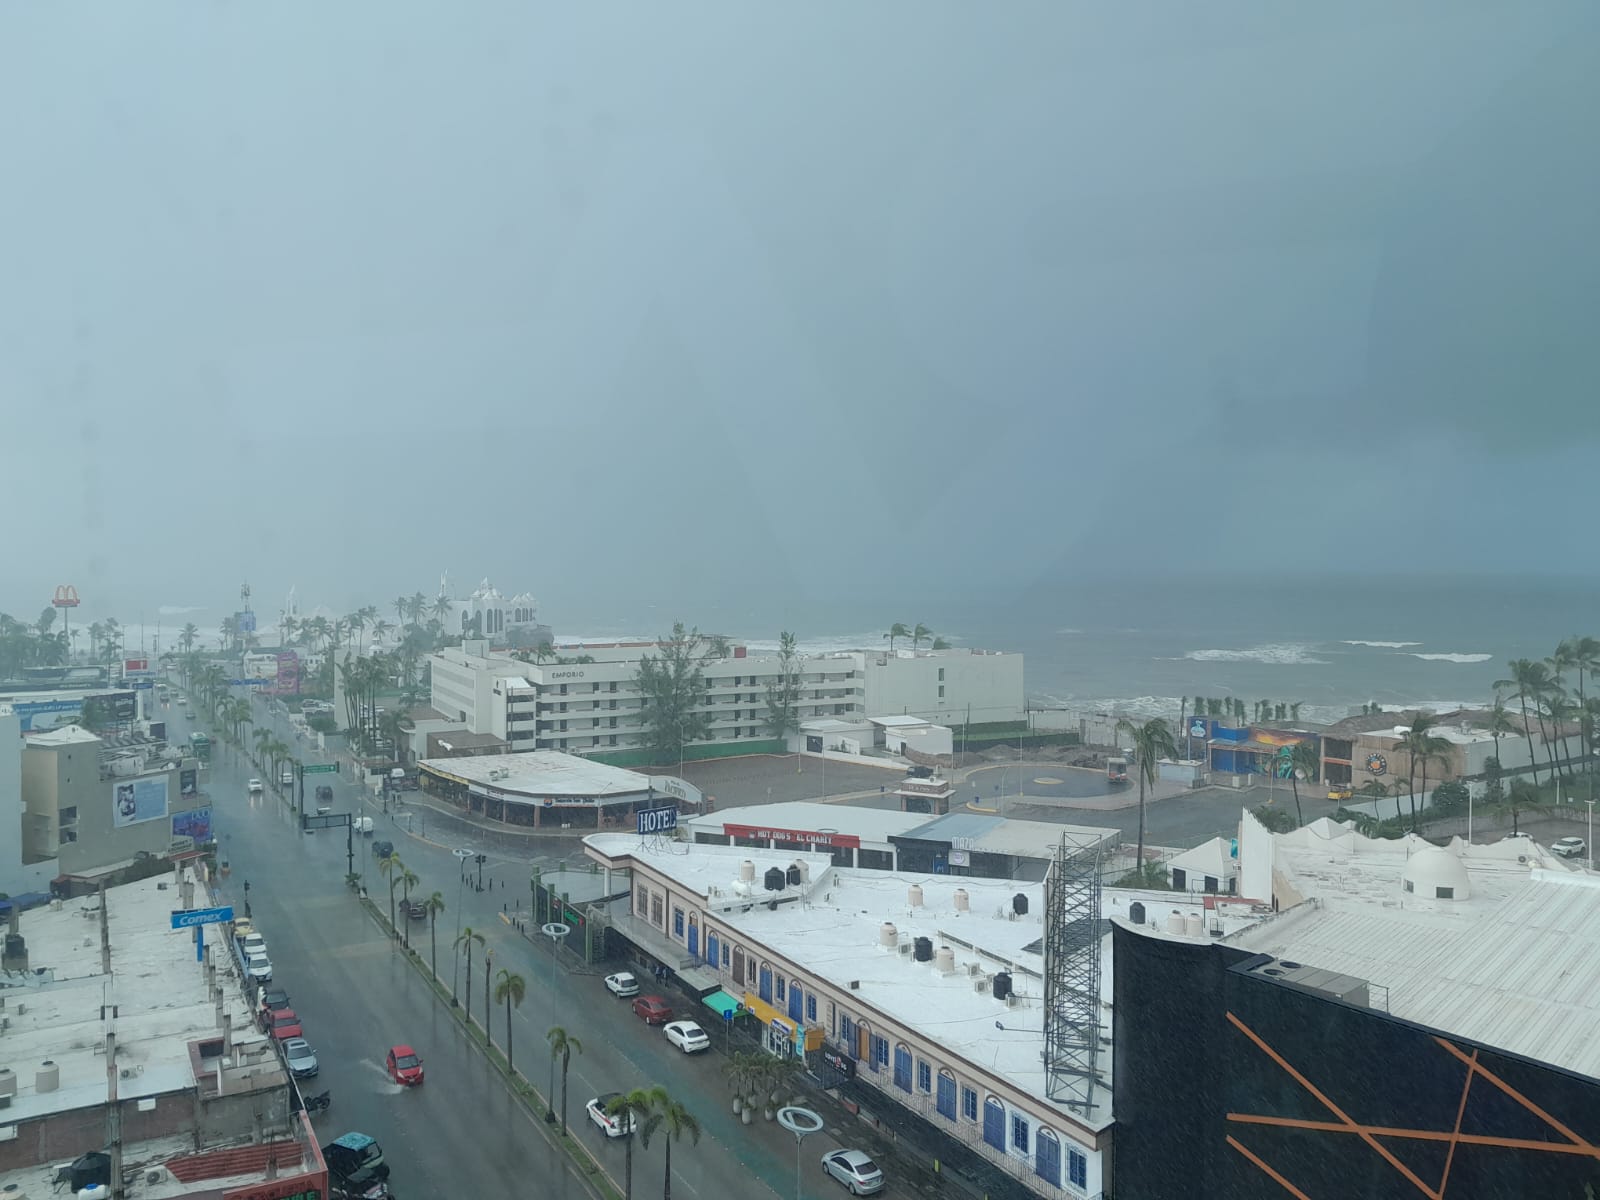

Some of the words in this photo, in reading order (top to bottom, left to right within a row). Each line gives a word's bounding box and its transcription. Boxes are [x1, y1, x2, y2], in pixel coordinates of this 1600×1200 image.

[552, 671, 584, 679] EMPORIO
[640, 808, 676, 833] HOTEL
[180, 910, 225, 926] Comex
